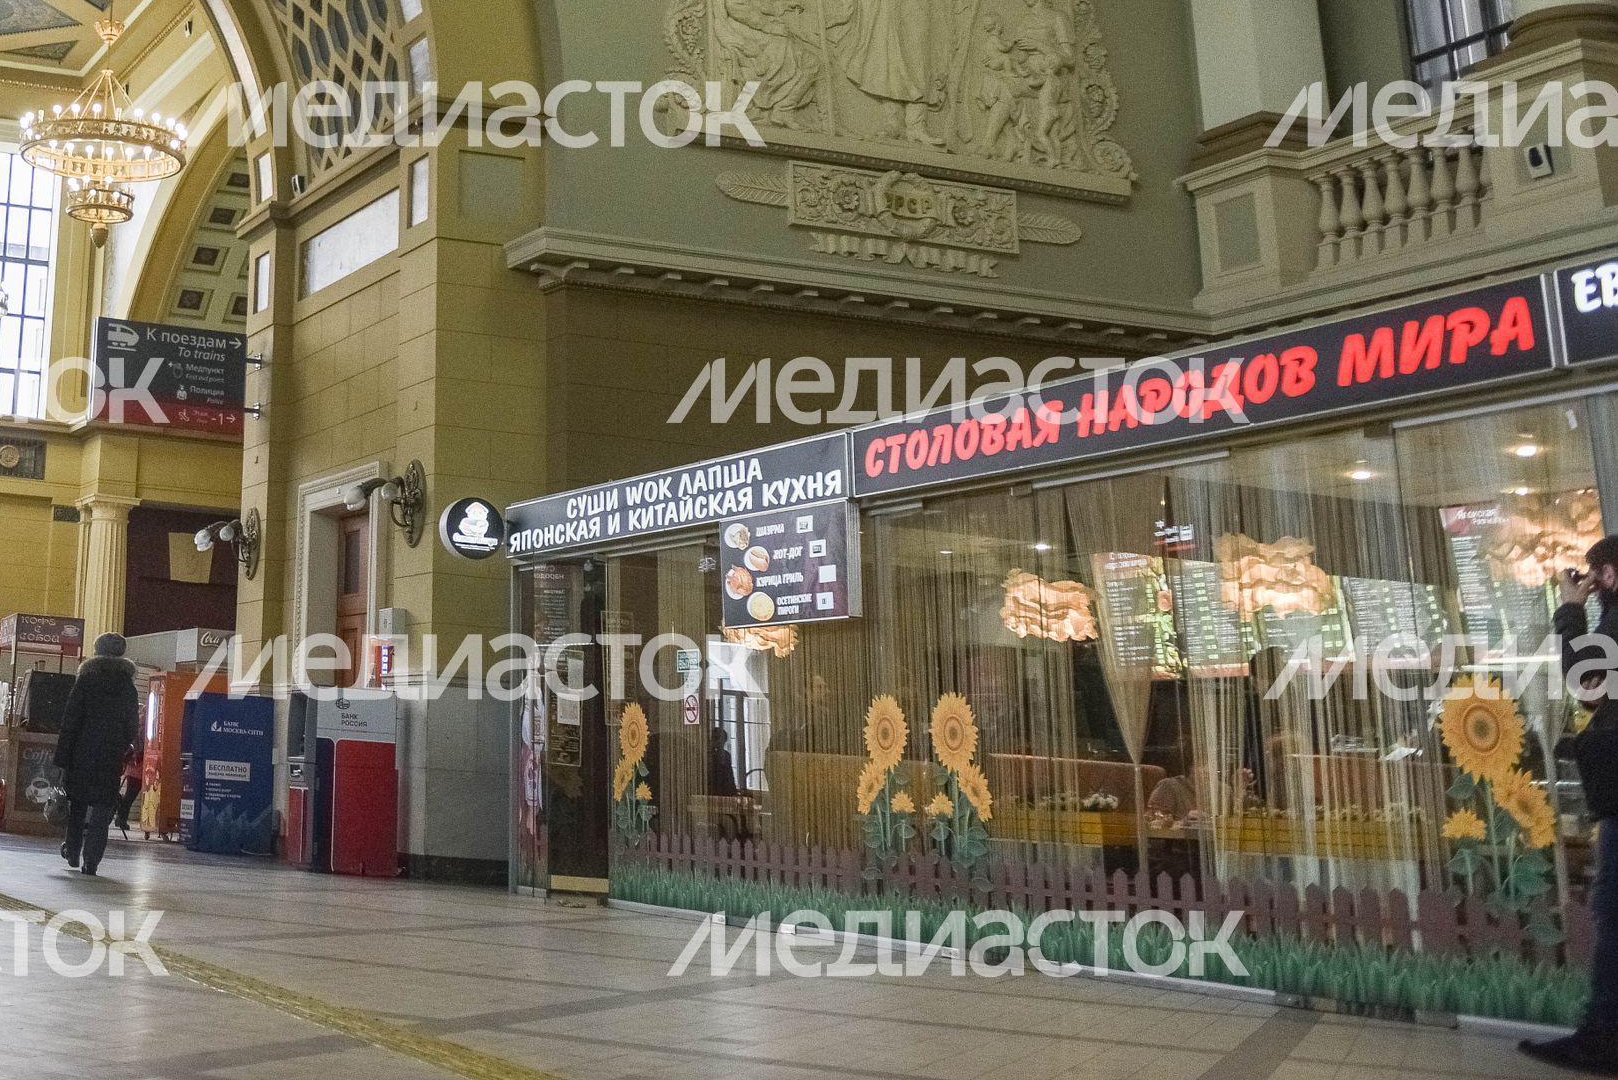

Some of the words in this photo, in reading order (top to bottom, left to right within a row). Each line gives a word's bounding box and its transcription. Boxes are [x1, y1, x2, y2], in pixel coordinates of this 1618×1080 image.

[146, 327, 157, 341] К
[161, 332, 227, 350] поездам
[178, 346, 191, 358] To
[193, 348, 226, 362] trains
[864, 399, 1064, 478] СТОЛОВАЯ
[1076, 345, 1320, 438] НАРОДОВ
[1336, 295, 1537, 388] МИРА
[566, 491, 619, 520] СУШИ
[626, 476, 673, 510] WOK
[677, 457, 763, 502] ЛАПША
[509, 512, 602, 553] ЯПОНСКАЯ
[608, 512, 623, 540] И
[628, 484, 754, 533] КИТАЙСКАЯ
[761, 469, 843, 508] КУХНЯ
[342, 712, 358, 720] БАНК
[208, 764, 248, 773] БЕСПЛАТНО
